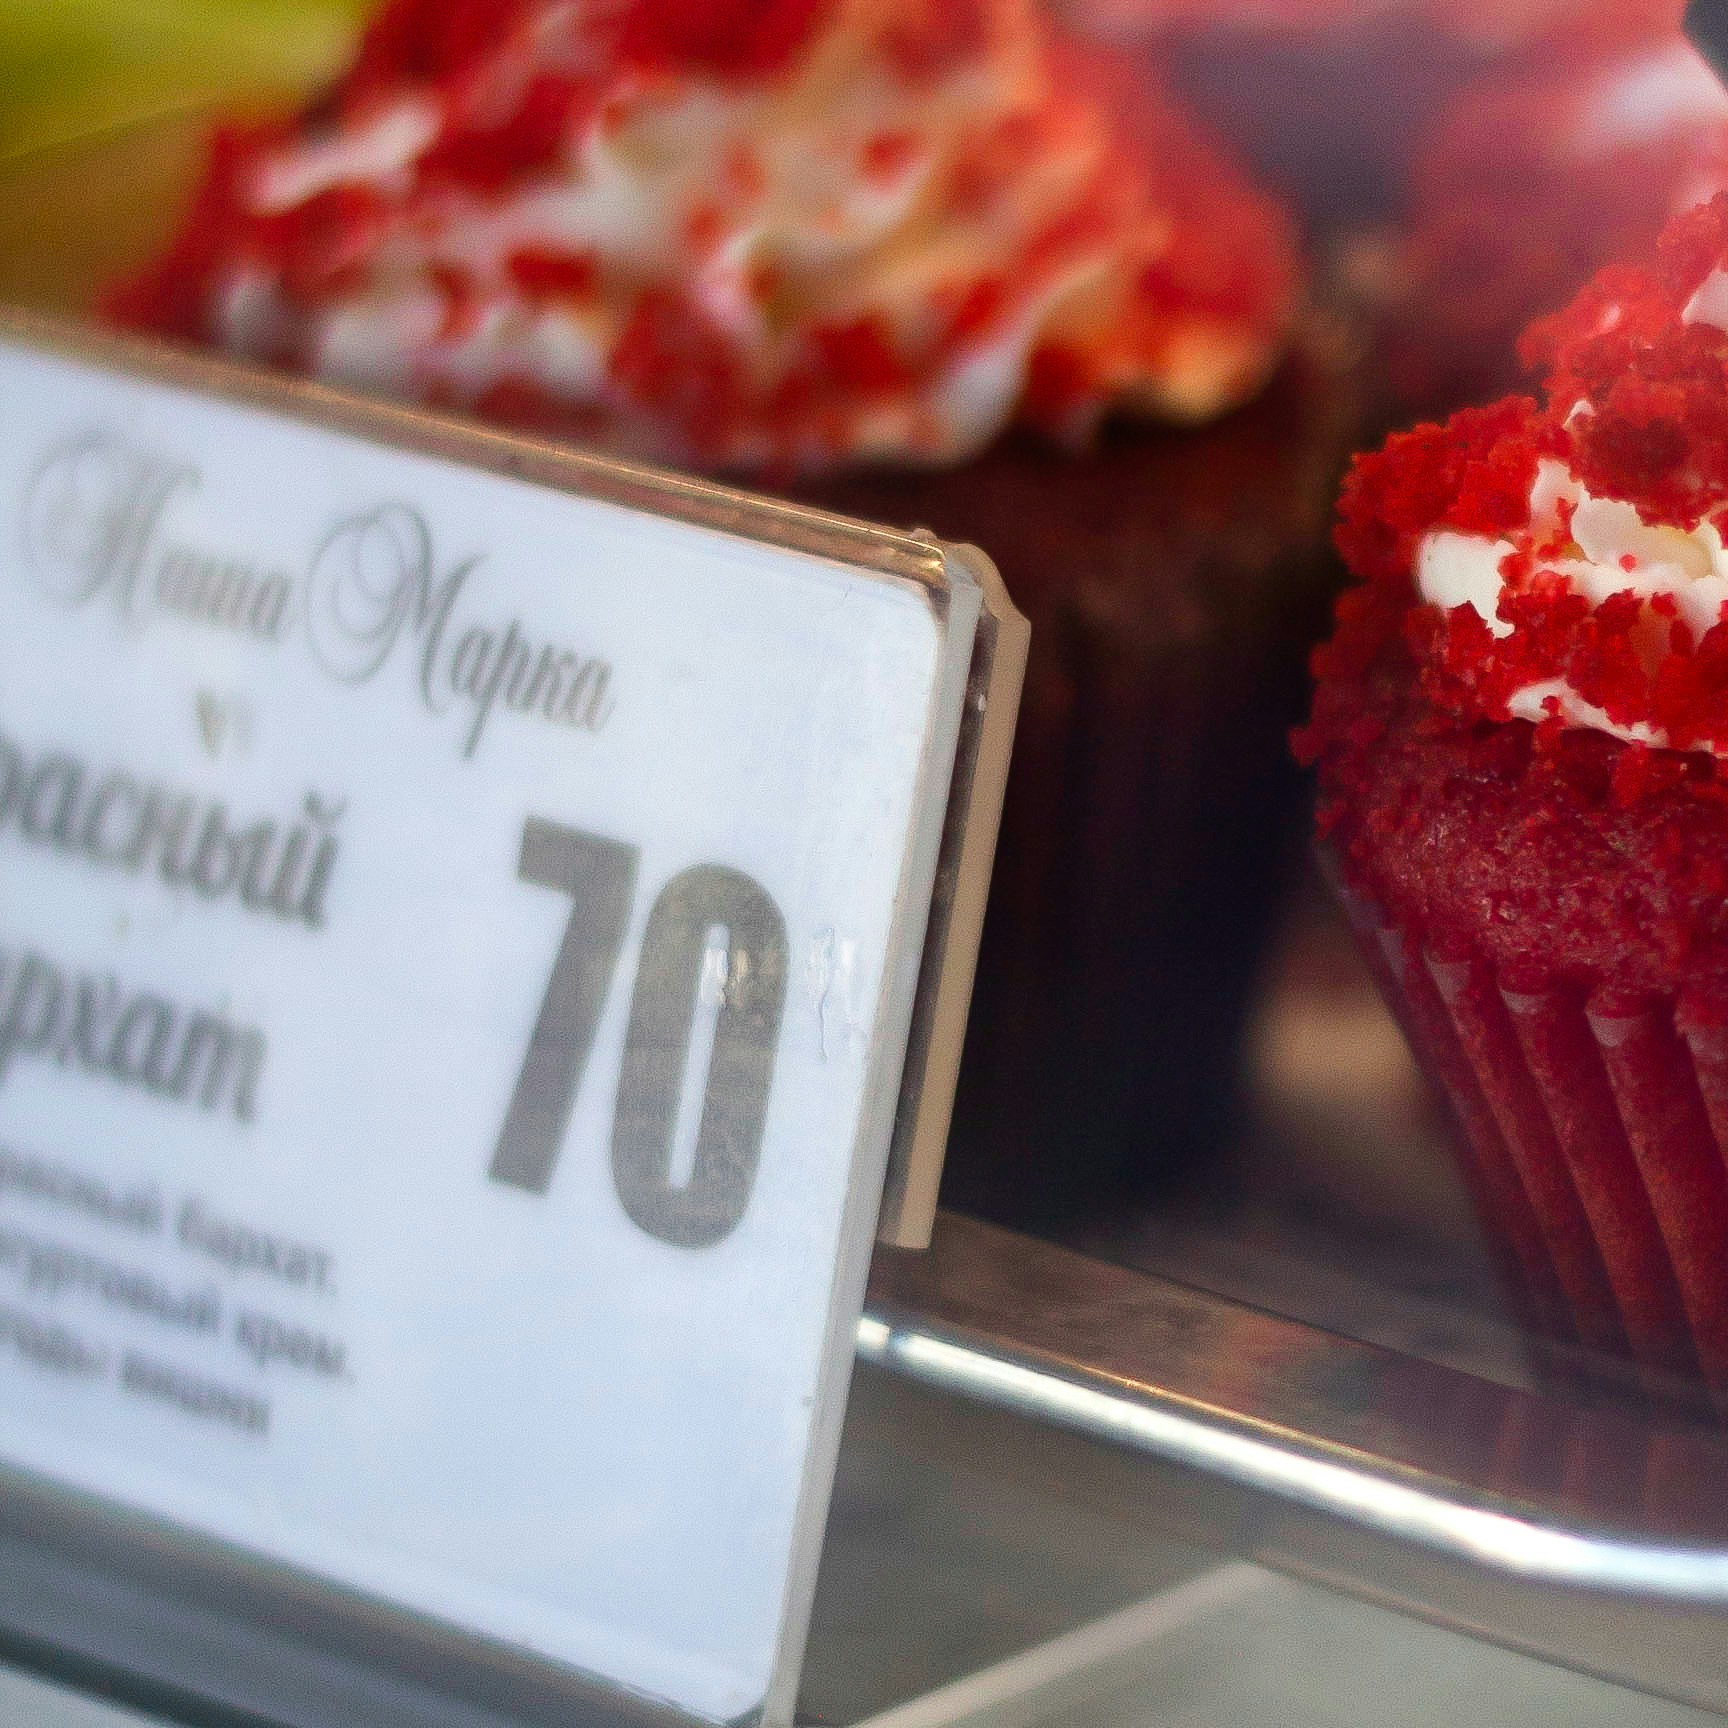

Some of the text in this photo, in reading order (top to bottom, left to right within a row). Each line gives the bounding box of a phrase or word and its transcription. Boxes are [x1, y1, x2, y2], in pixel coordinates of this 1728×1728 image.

[305, 501, 617, 761] Марка
[0, 944, 267, 1125] рхат
[488, 813, 791, 1251] 70
